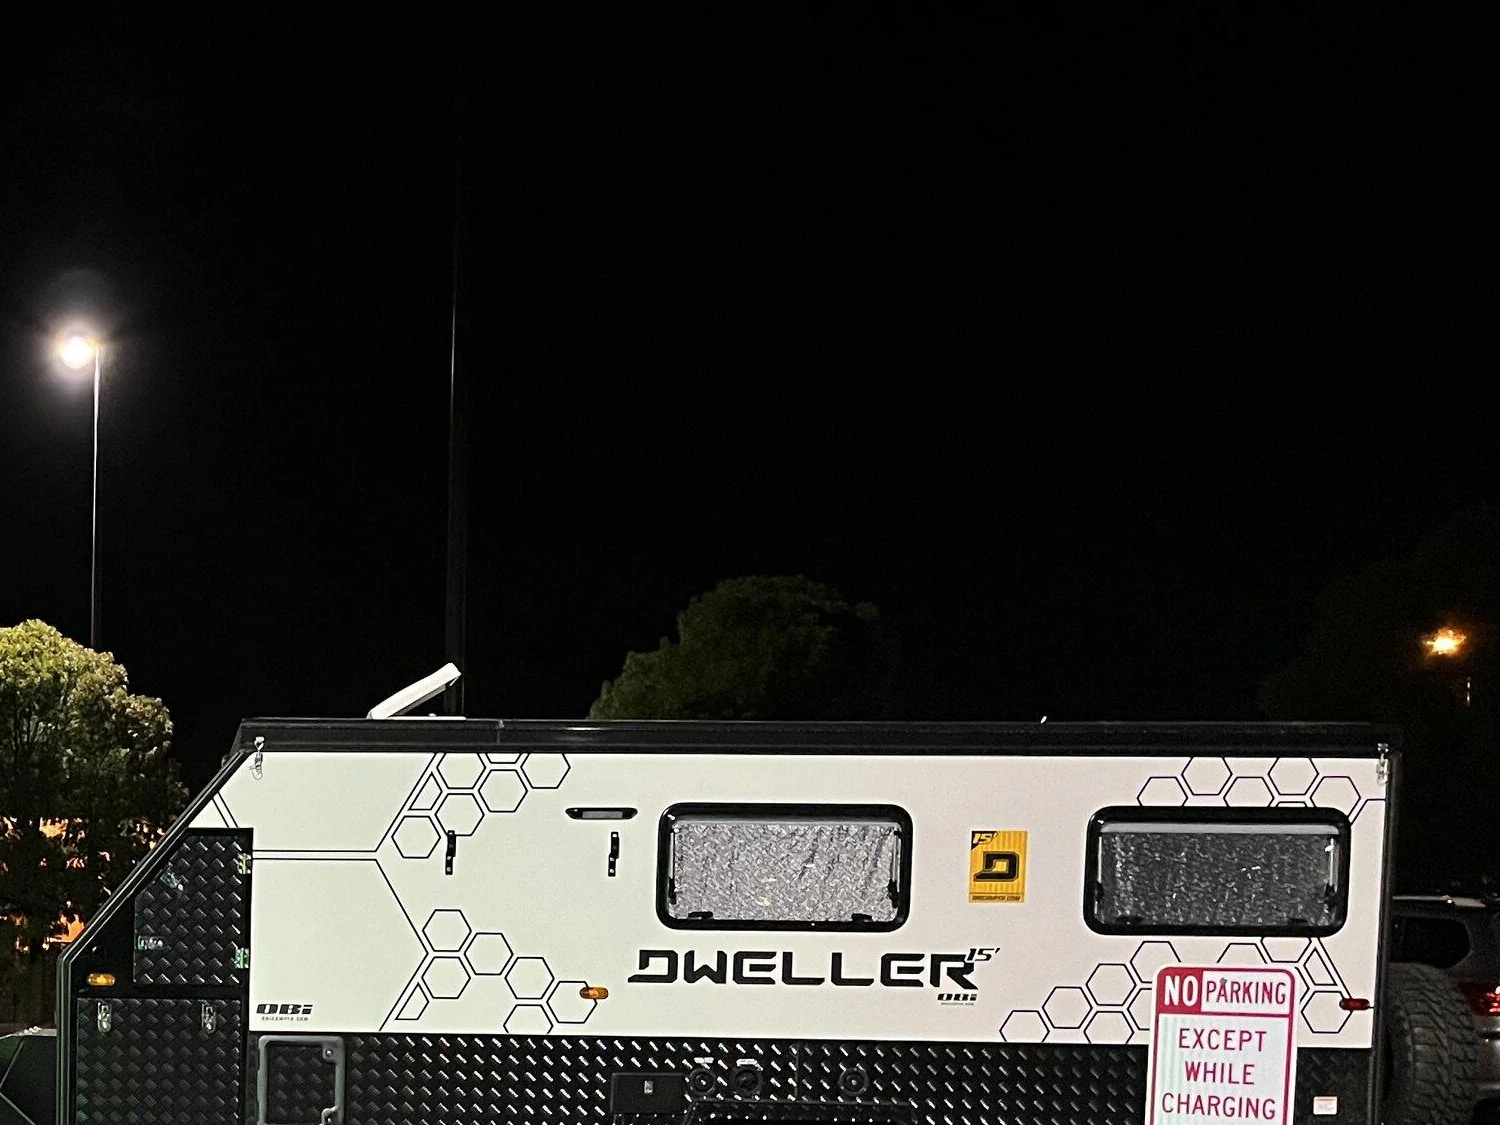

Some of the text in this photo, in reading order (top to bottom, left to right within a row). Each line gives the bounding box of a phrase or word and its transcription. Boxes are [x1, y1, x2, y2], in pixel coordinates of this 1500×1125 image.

[627, 949, 978, 990] DWELLER
[1164, 975, 1287, 1007] NO PARKING
[1178, 1028, 1267, 1052] EXCEPT
[1184, 1060, 1255, 1085] WHILE
[1161, 1092, 1276, 1120] CHARGING
